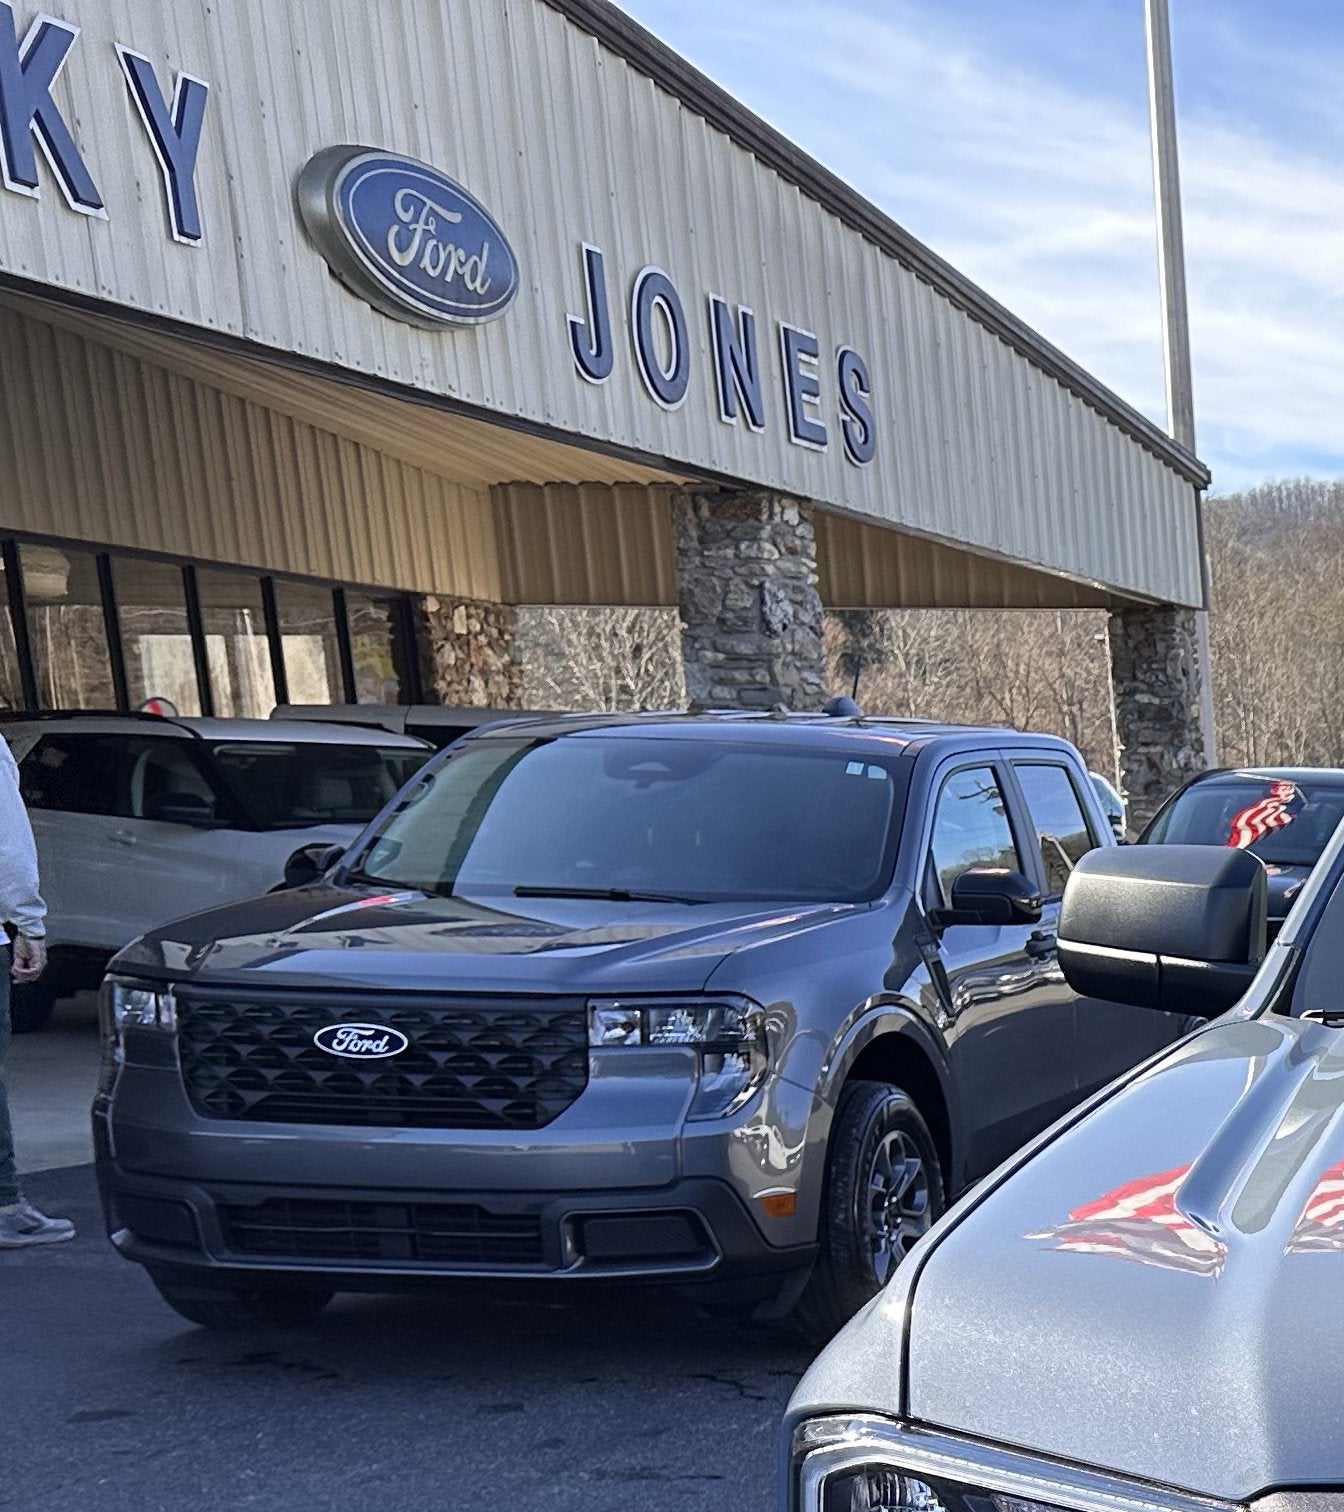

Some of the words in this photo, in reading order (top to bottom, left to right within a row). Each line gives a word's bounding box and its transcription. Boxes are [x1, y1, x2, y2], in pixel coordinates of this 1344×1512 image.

[388, 187, 492, 295] Ford
[566, 242, 877, 468] JONES
[331, 1027, 390, 1053] Ford
